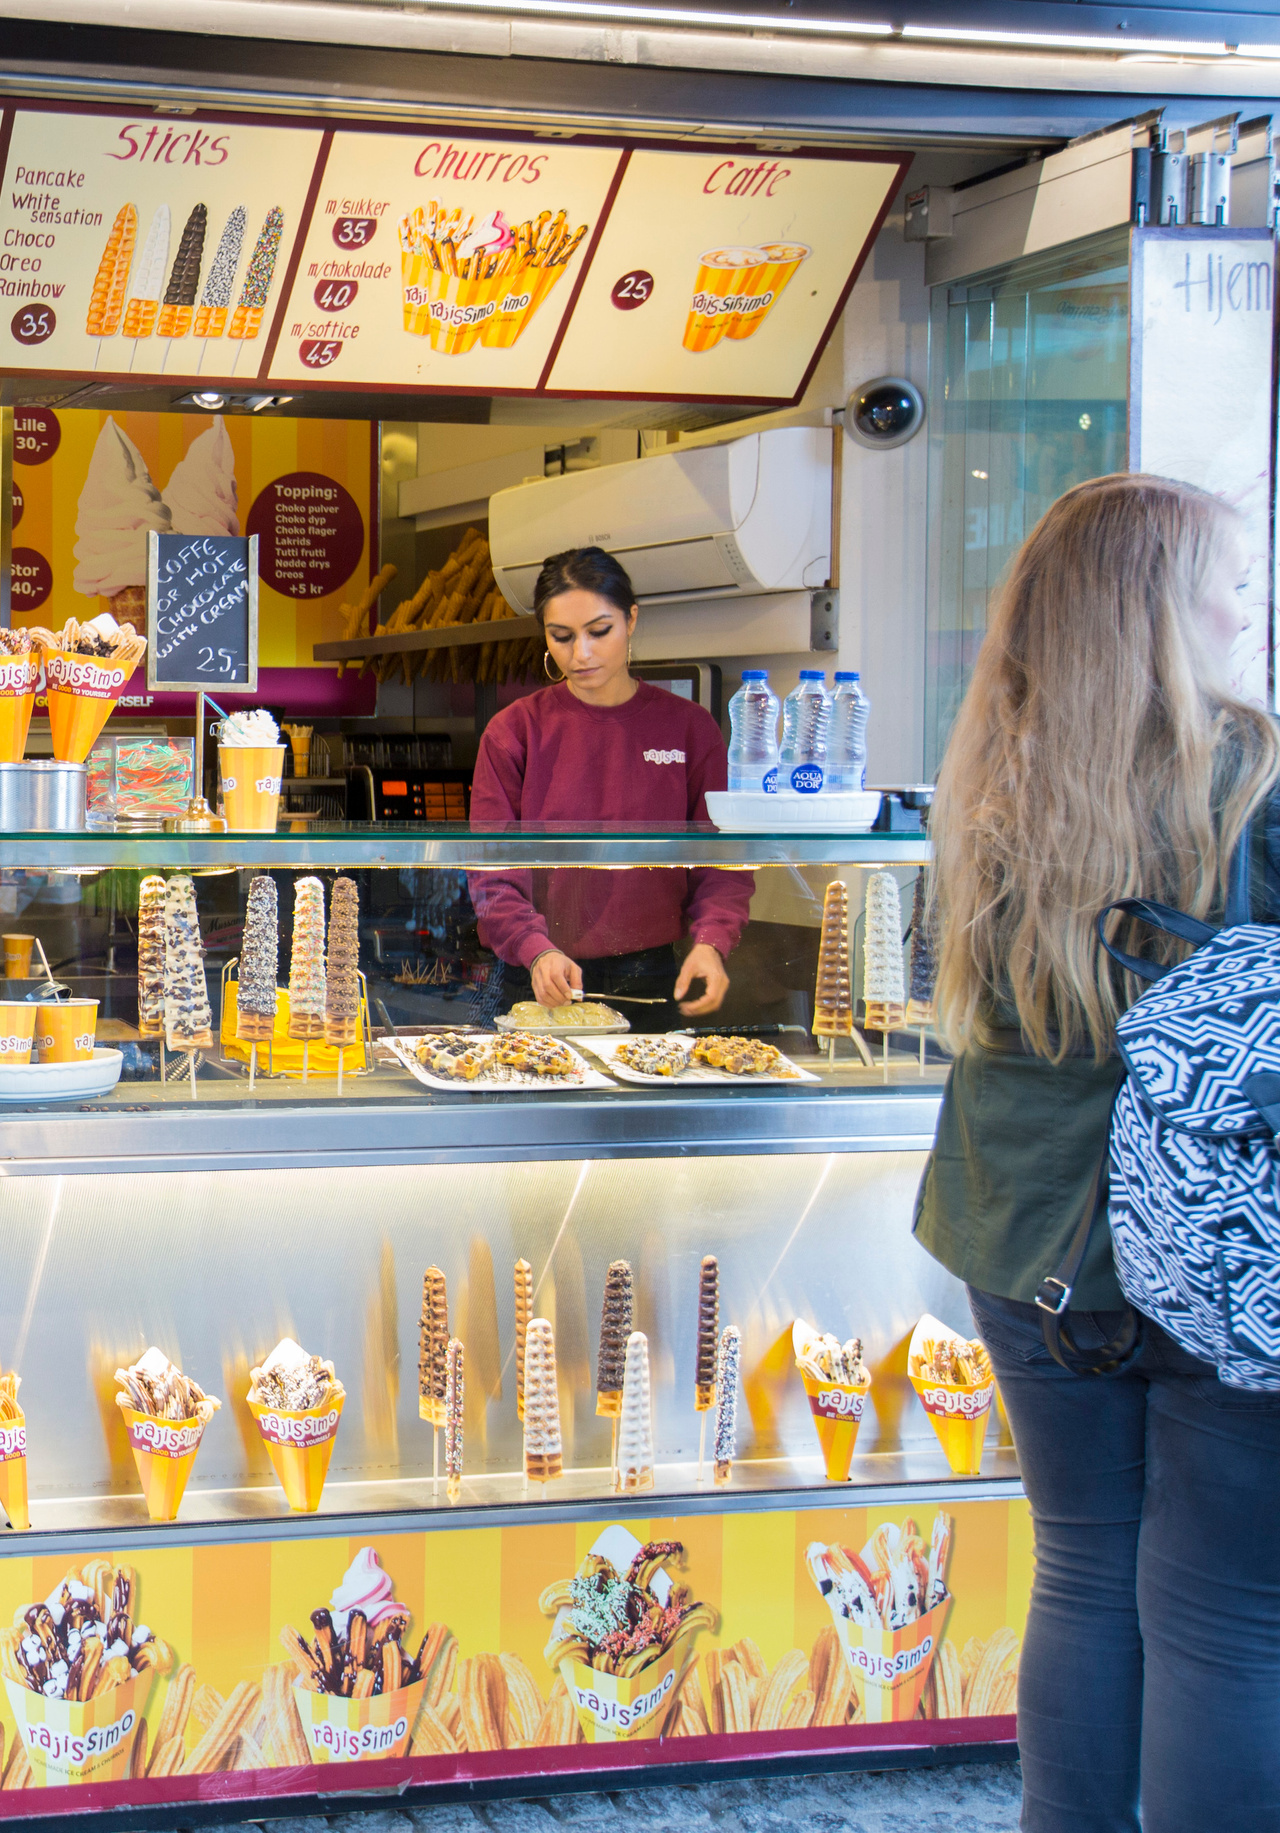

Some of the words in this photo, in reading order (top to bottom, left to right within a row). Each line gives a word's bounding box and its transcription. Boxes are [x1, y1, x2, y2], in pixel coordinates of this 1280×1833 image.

[102, 123, 230, 166] Sticks
[413, 142, 549, 185] Churros
[15, 166, 85, 189] Pancake
[12, 192, 60, 211] White
[325, 197, 390, 216] m/sukker
[30, 208, 103, 226] sensation
[4, 228, 55, 248] Choco
[0, 254, 41, 272] Oreo
[307, 260, 392, 279] m/chokolade
[1173, 252, 1271, 326] Hjem
[290, 320, 360, 339] m/softice
[14, 419, 47, 432] Lille
[16, 437, 49, 452] 30,-
[274, 485, 338, 500] Topping:
[275, 504, 306, 513] Choko
[308, 504, 340, 515] pulver
[275, 515, 306, 524] Choko
[308, 516, 326, 526] dyp
[275, 526, 306, 535] Choko
[308, 526, 337, 537] flager
[275, 537, 311, 546] Lakrids
[275, 548, 298, 557] Tutti
[301, 548, 326, 557] frutti
[275, 570, 304, 579] Oreos
[309, 560, 330, 570] drys
[157, 588, 181, 611] OR
[185, 550, 228, 586] HOT
[289, 584, 306, 594] +5
[310, 584, 323, 594] kr
[201, 580, 249, 624] CREAM
[49, 659, 122, 685] rajissimo
[81, 689, 112, 699] YOURSELF
[117, 697, 154, 707] RSELF
[793, 772, 822, 781] AQUA
[822, 1391, 863, 1411] rajis
[262, 1411, 336, 1437] rajissimo
[850, 1639, 931, 1678] rajissimo
[577, 1674, 673, 1725] rajissimo
[29, 1714, 132, 1761] rajissimo
[314, 1721, 405, 1755] rajissimo
